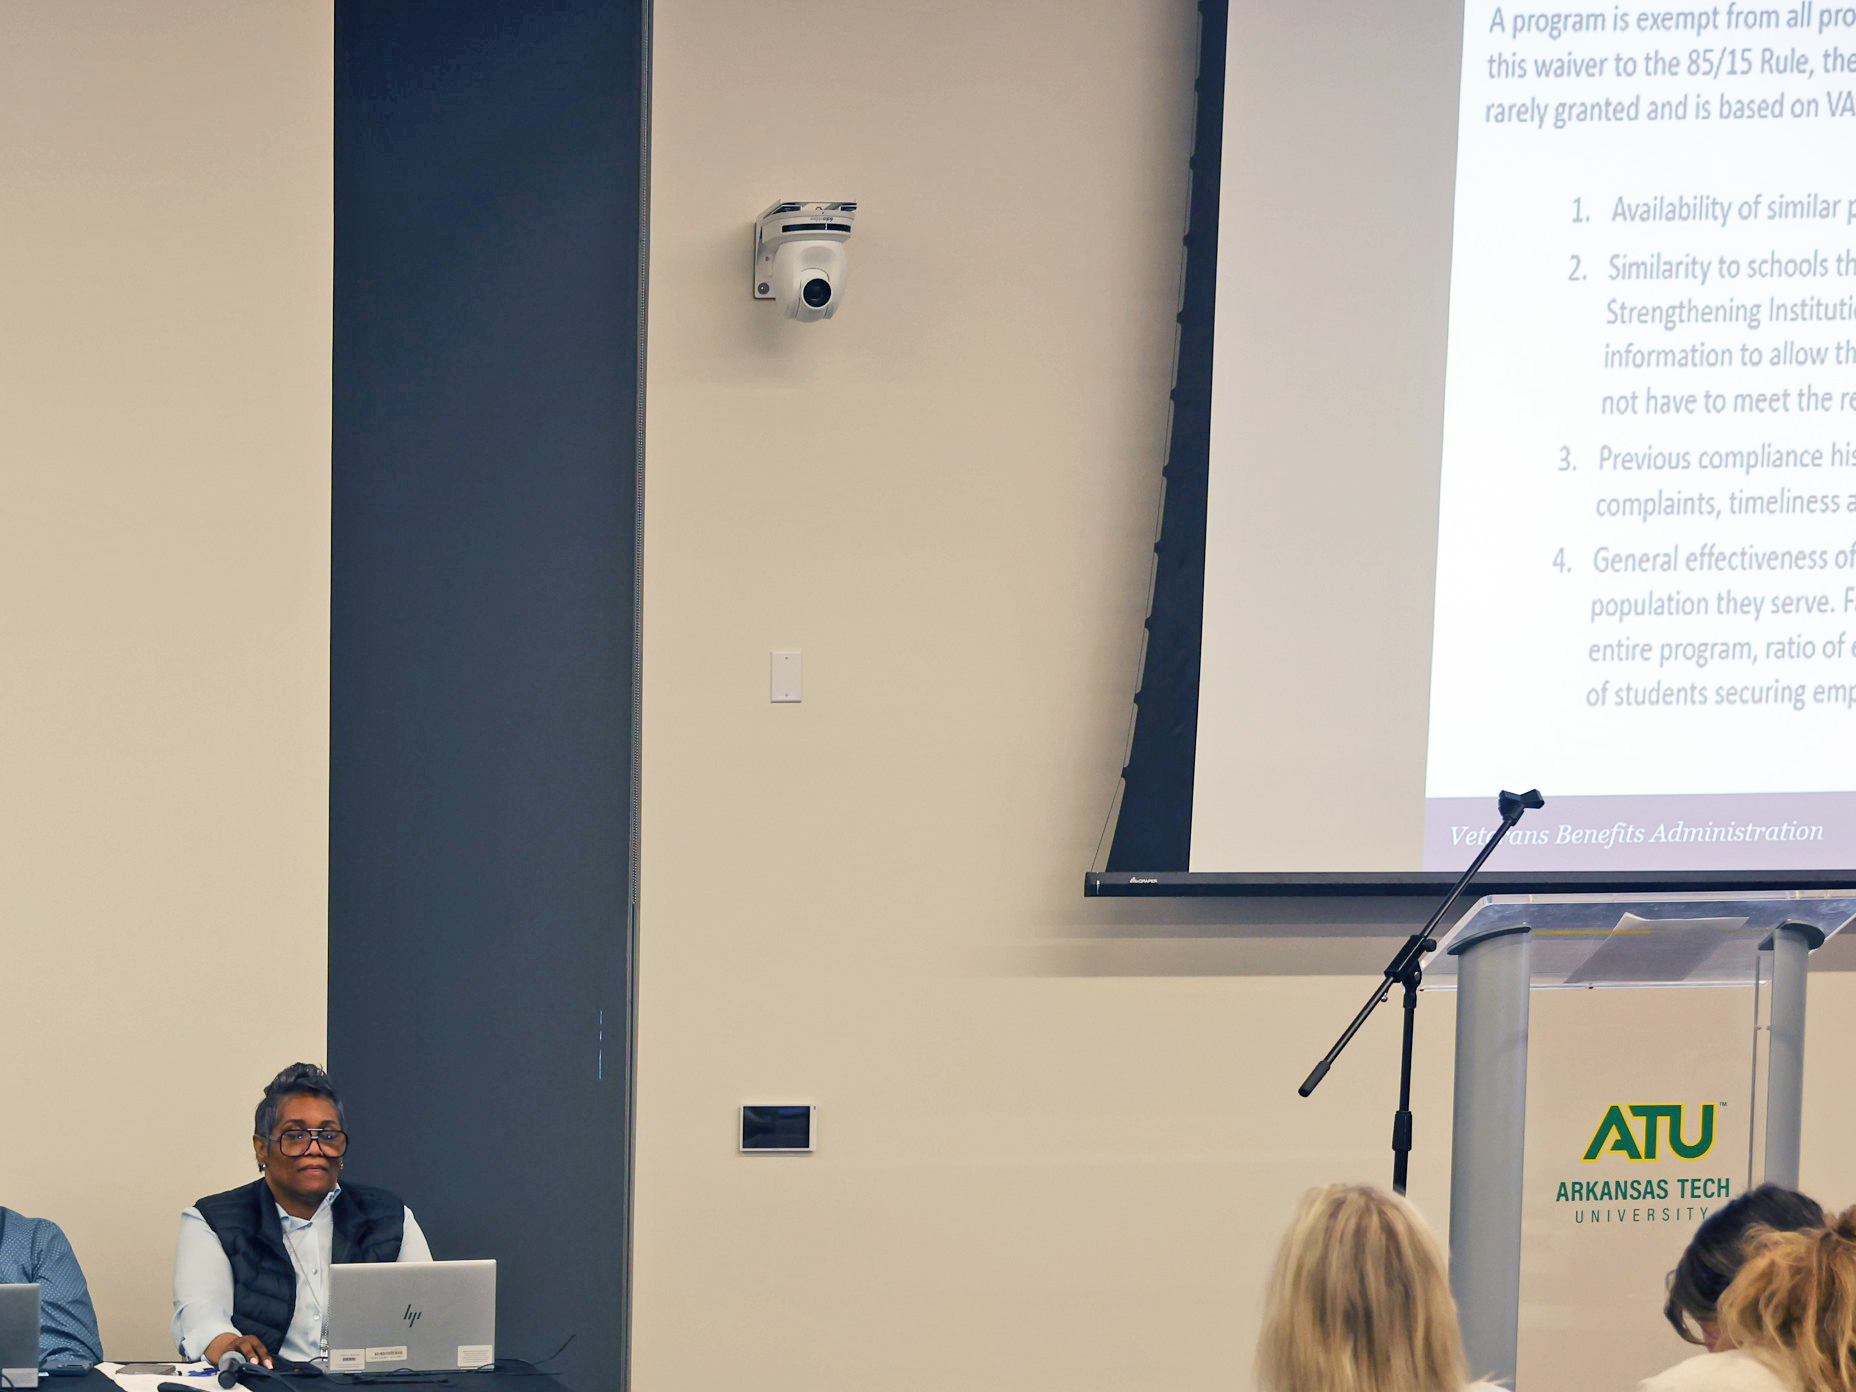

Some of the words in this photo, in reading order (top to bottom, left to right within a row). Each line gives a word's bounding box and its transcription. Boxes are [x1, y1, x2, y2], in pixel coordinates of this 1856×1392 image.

[1489, 6, 1506, 34] A
[1511, 12, 1606, 41] program
[1613, 4, 1629, 32] is
[1636, 6, 1720, 38] exempt
[1726, 0, 1780, 30] from
[1786, 0, 1813, 29] all
[1818, 7, 1856, 35] pro
[1487, 51, 1527, 79] this
[1533, 51, 1609, 78] waiver
[1614, 52, 1638, 77] to
[1643, 49, 1681, 77] the
[1686, 46, 1753, 80] 85/15
[1760, 47, 1815, 80] Rule,
[1822, 45, 1856, 74] the
[1485, 95, 1549, 130] rarely
[1553, 94, 1641, 130] granted
[1646, 93, 1688, 121] and
[1695, 93, 1711, 120] is
[1719, 91, 1785, 120] based
[1790, 97, 1819, 118] on
[1826, 90, 1856, 117] VA
[1572, 196, 1590, 223] 1.
[1611, 194, 1733, 228] Availability
[1737, 193, 1762, 221] of
[1766, 192, 1842, 220] similar
[1568, 254, 1587, 281] 2.
[1608, 251, 1712, 286] Similarity
[1718, 255, 1741, 279] to
[1747, 249, 1829, 279] schools
[1835, 248, 1856, 277] th
[1606, 297, 1762, 332] Strengthening
[1769, 294, 1856, 322] Instituti
[1604, 341, 1733, 369] information
[1740, 343, 1763, 367] to
[1769, 340, 1829, 367] allow
[1835, 339, 1856, 365] th
[1602, 391, 1639, 415] not
[1645, 386, 1698, 415] have
[1703, 390, 1727, 414] to
[1733, 388, 1791, 413] meet
[1797, 383, 1833, 412] the
[1558, 445, 1577, 471] 3.
[1599, 444, 1691, 471] Previous
[1698, 442, 1823, 476] compliance
[1596, 489, 1721, 523] complaints,
[1729, 486, 1840, 515] timeliness
[1552, 547, 1571, 573] 4.
[1593, 544, 1678, 573] General
[1685, 543, 1828, 572] effectiveness
[1834, 540, 1856, 569] of
[1590, 590, 1709, 624] population
[1716, 589, 1765, 622] they
[1770, 594, 1835, 614] serve.
[1844, 586, 1856, 613] F
[1588, 636, 1653, 662] entire
[1659, 641, 1758, 669] program,
[1766, 633, 1816, 660] ratio
[1822, 630, 1846, 659] of
[1586, 680, 1610, 707] of
[1614, 679, 1708, 706] students
[1714, 678, 1806, 711] securing
[1554, 822, 1646, 848] Benefits
[1648, 820, 1824, 844] Administration
[1579, 1102, 1718, 1163] ATU
[1555, 1178, 1669, 1202] ARKANSAS
[1676, 1177, 1731, 1199] TECH
[1575, 1207, 1710, 1224] UNIVERSITY
